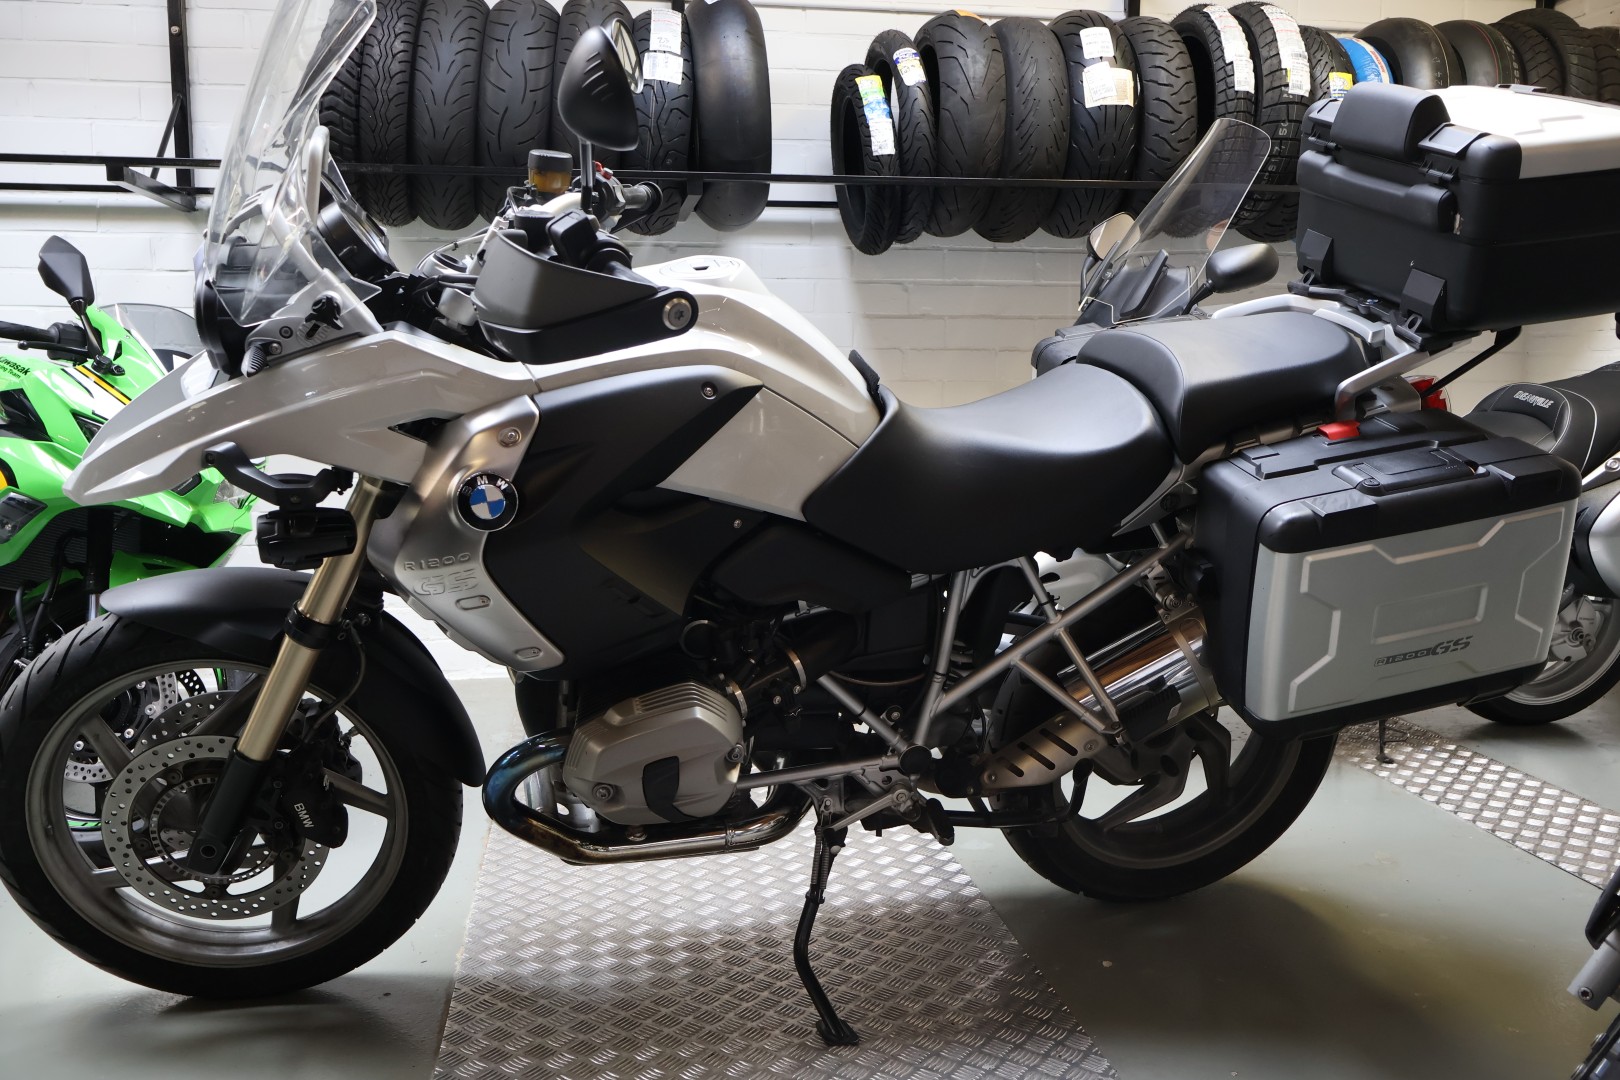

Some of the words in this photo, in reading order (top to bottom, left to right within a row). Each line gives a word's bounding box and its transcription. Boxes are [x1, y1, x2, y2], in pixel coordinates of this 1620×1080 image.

[0, 357, 30, 375] awasak
[462, 475, 510, 497] BMW
[404, 552, 471, 571] R1200
[413, 568, 479, 596] GS
[293, 802, 315, 828] BMW
